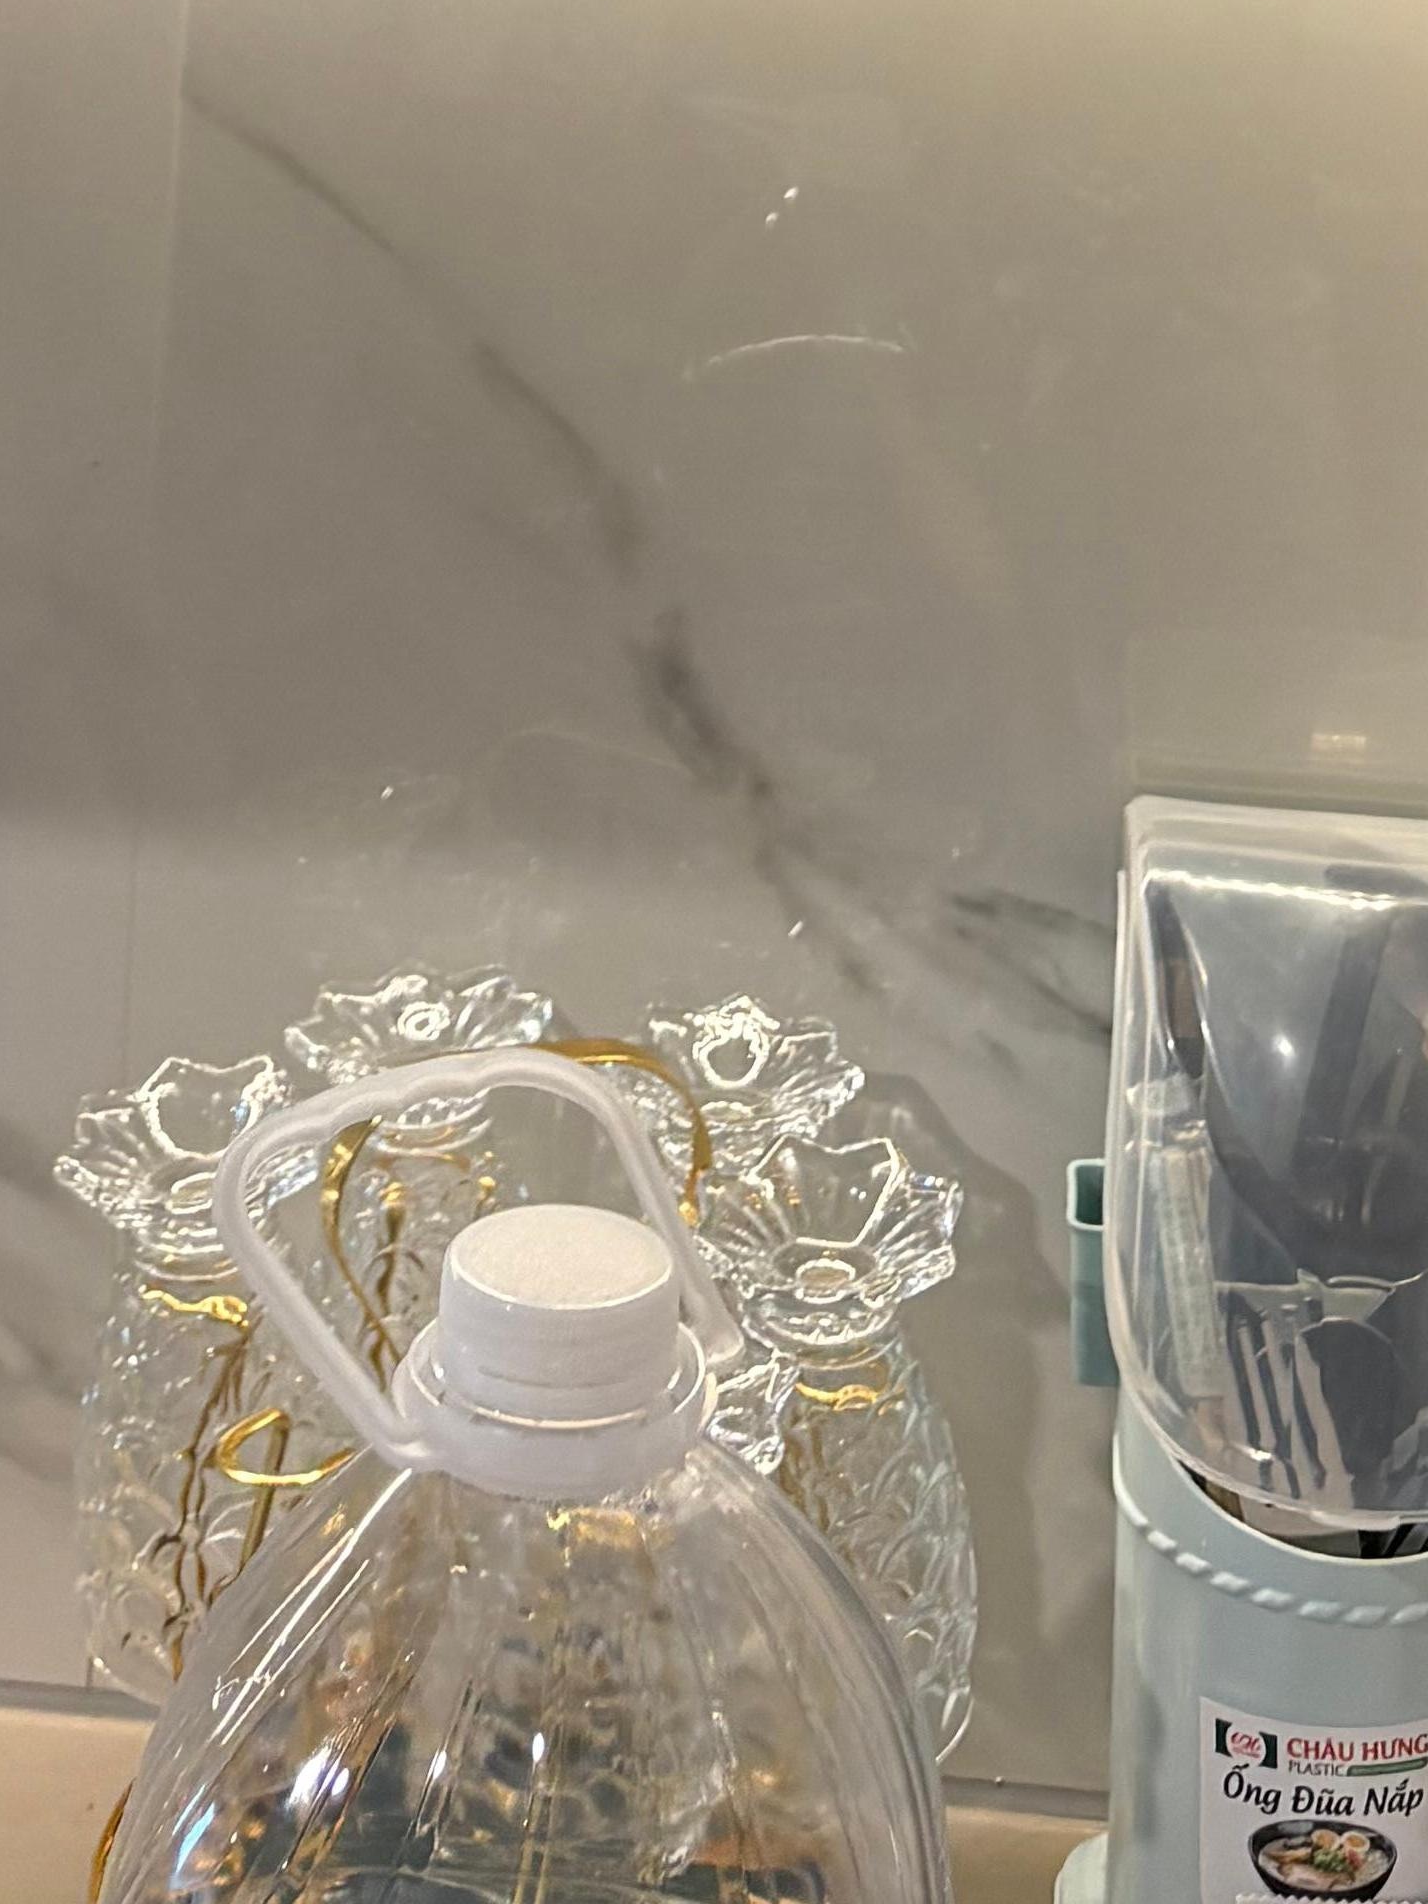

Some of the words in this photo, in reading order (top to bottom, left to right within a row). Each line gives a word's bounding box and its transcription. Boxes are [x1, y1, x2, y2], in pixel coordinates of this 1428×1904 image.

[1286, 1737, 1354, 1761] CHÂU
[1288, 1760, 1346, 1777] PLASTIC
[1223, 1763, 1282, 1815] Ống
[1291, 1785, 1355, 1817] Đũa
[1363, 1778, 1425, 1817] Nắp
